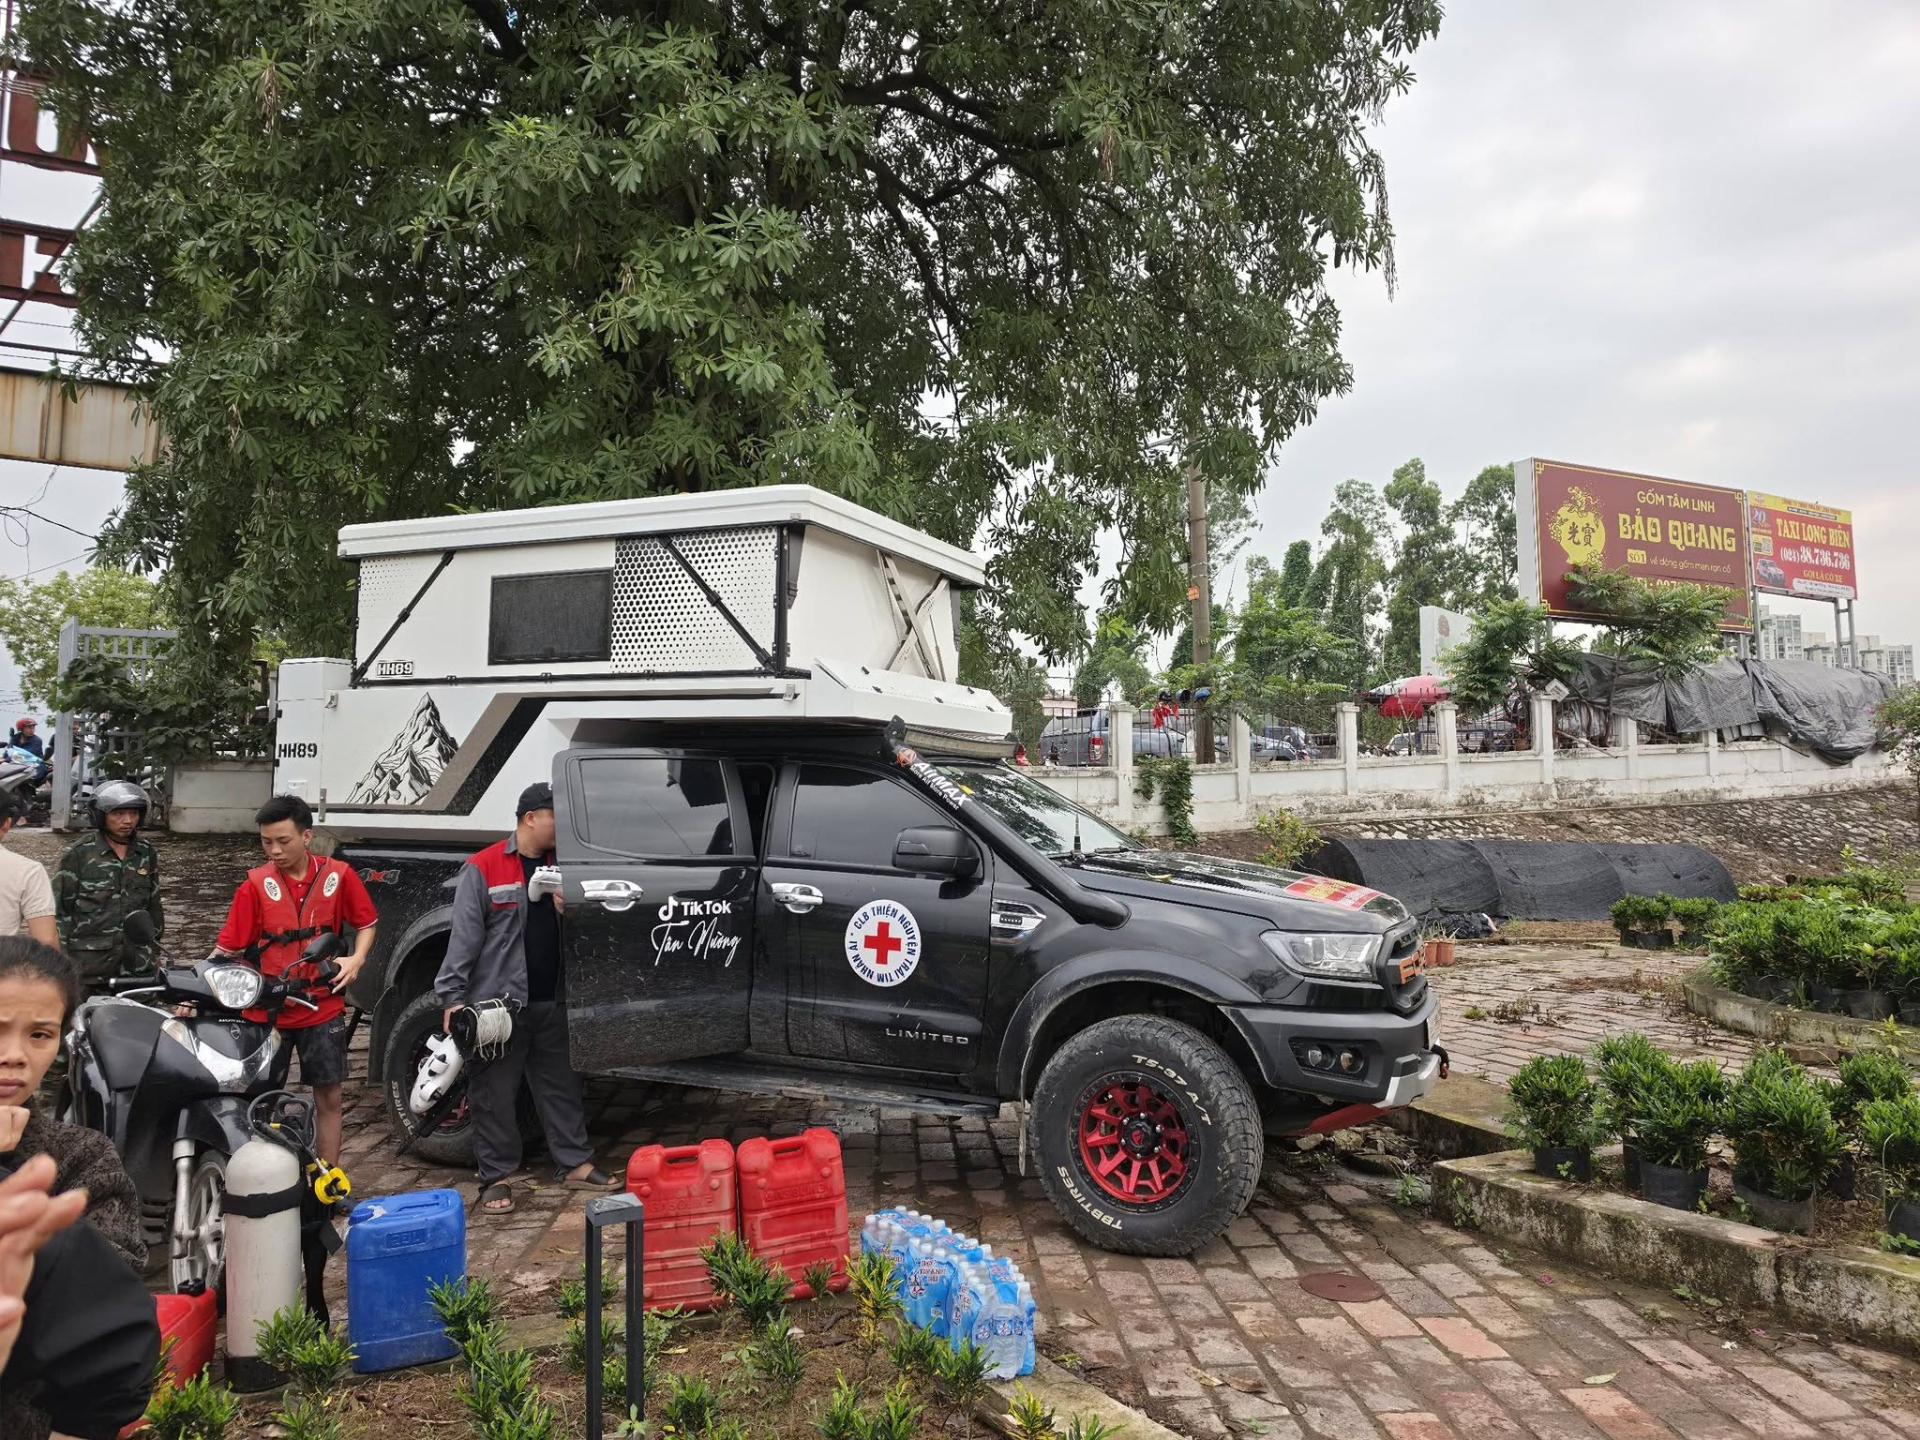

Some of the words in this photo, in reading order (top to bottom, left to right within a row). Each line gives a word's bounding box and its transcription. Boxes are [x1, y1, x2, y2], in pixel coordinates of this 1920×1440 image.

[1637, 488, 1665, 506] GỐM
[1667, 493, 1690, 510] TÂM
[1692, 499, 1716, 513] LINH
[1618, 507, 1662, 543] BẢO
[1668, 519, 1736, 552] QUANG
[1776, 518, 1800, 540] TAXI
[1801, 523, 1827, 545] LONG
[1828, 524, 1850, 549] BIÊN
[377, 661, 414, 676] HH89
[278, 743, 318, 758] HH89
[681, 900, 732, 916] TikTok
[871, 904, 898, 918] THIỆN
[853, 911, 869, 929] CLB
[898, 914, 918, 956] NGUYỆN
[852, 953, 875, 980] NHÂN
[877, 972, 895, 983] TIM
[886, 1028, 969, 1045] LIMITED
[1132, 1054, 1188, 1086] TS-37
[1185, 1091, 1212, 1126] A/T
[765, 1182, 827, 1201] GASOLINE
[651, 1196, 714, 1213] GASOLINE
